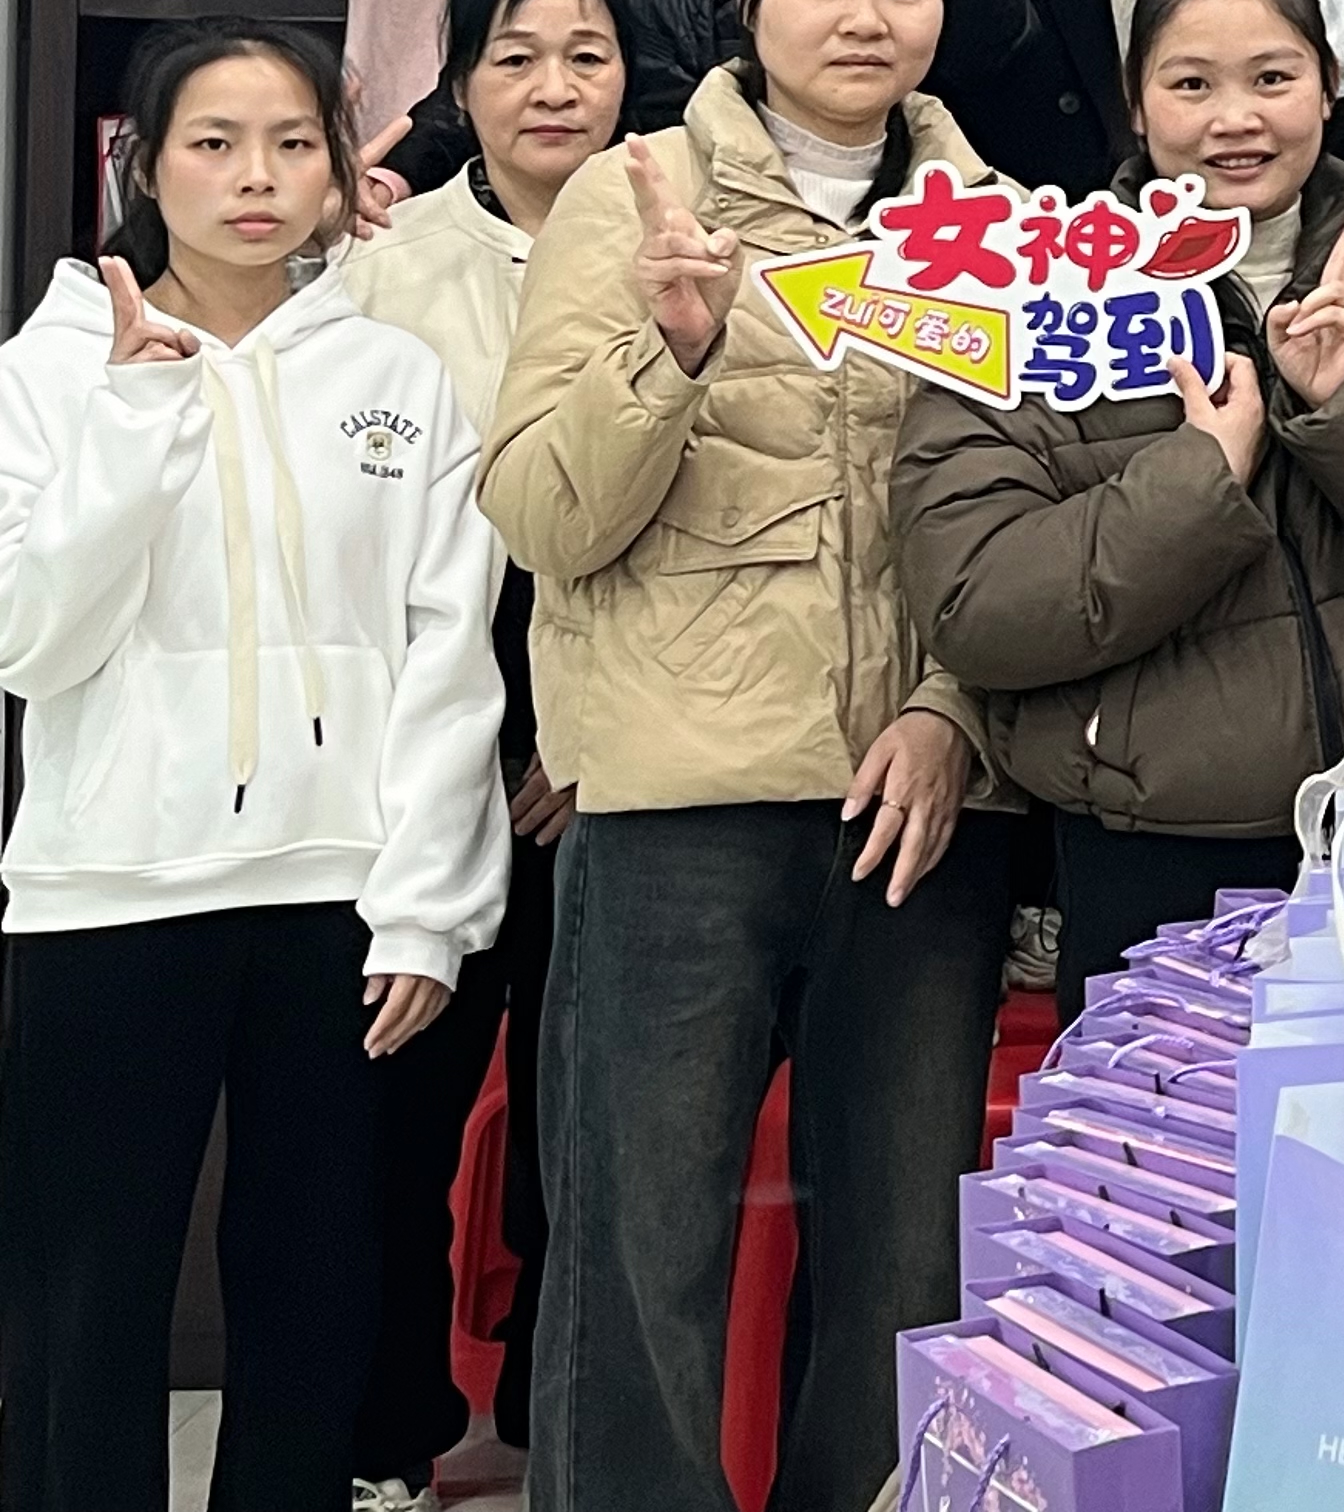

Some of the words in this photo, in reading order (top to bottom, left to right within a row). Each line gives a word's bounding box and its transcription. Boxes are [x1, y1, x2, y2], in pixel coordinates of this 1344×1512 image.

[879, 168, 1141, 292] 女神
[1018, 289, 1216, 402] 驾到
[339, 409, 424, 445] CALSTATE
